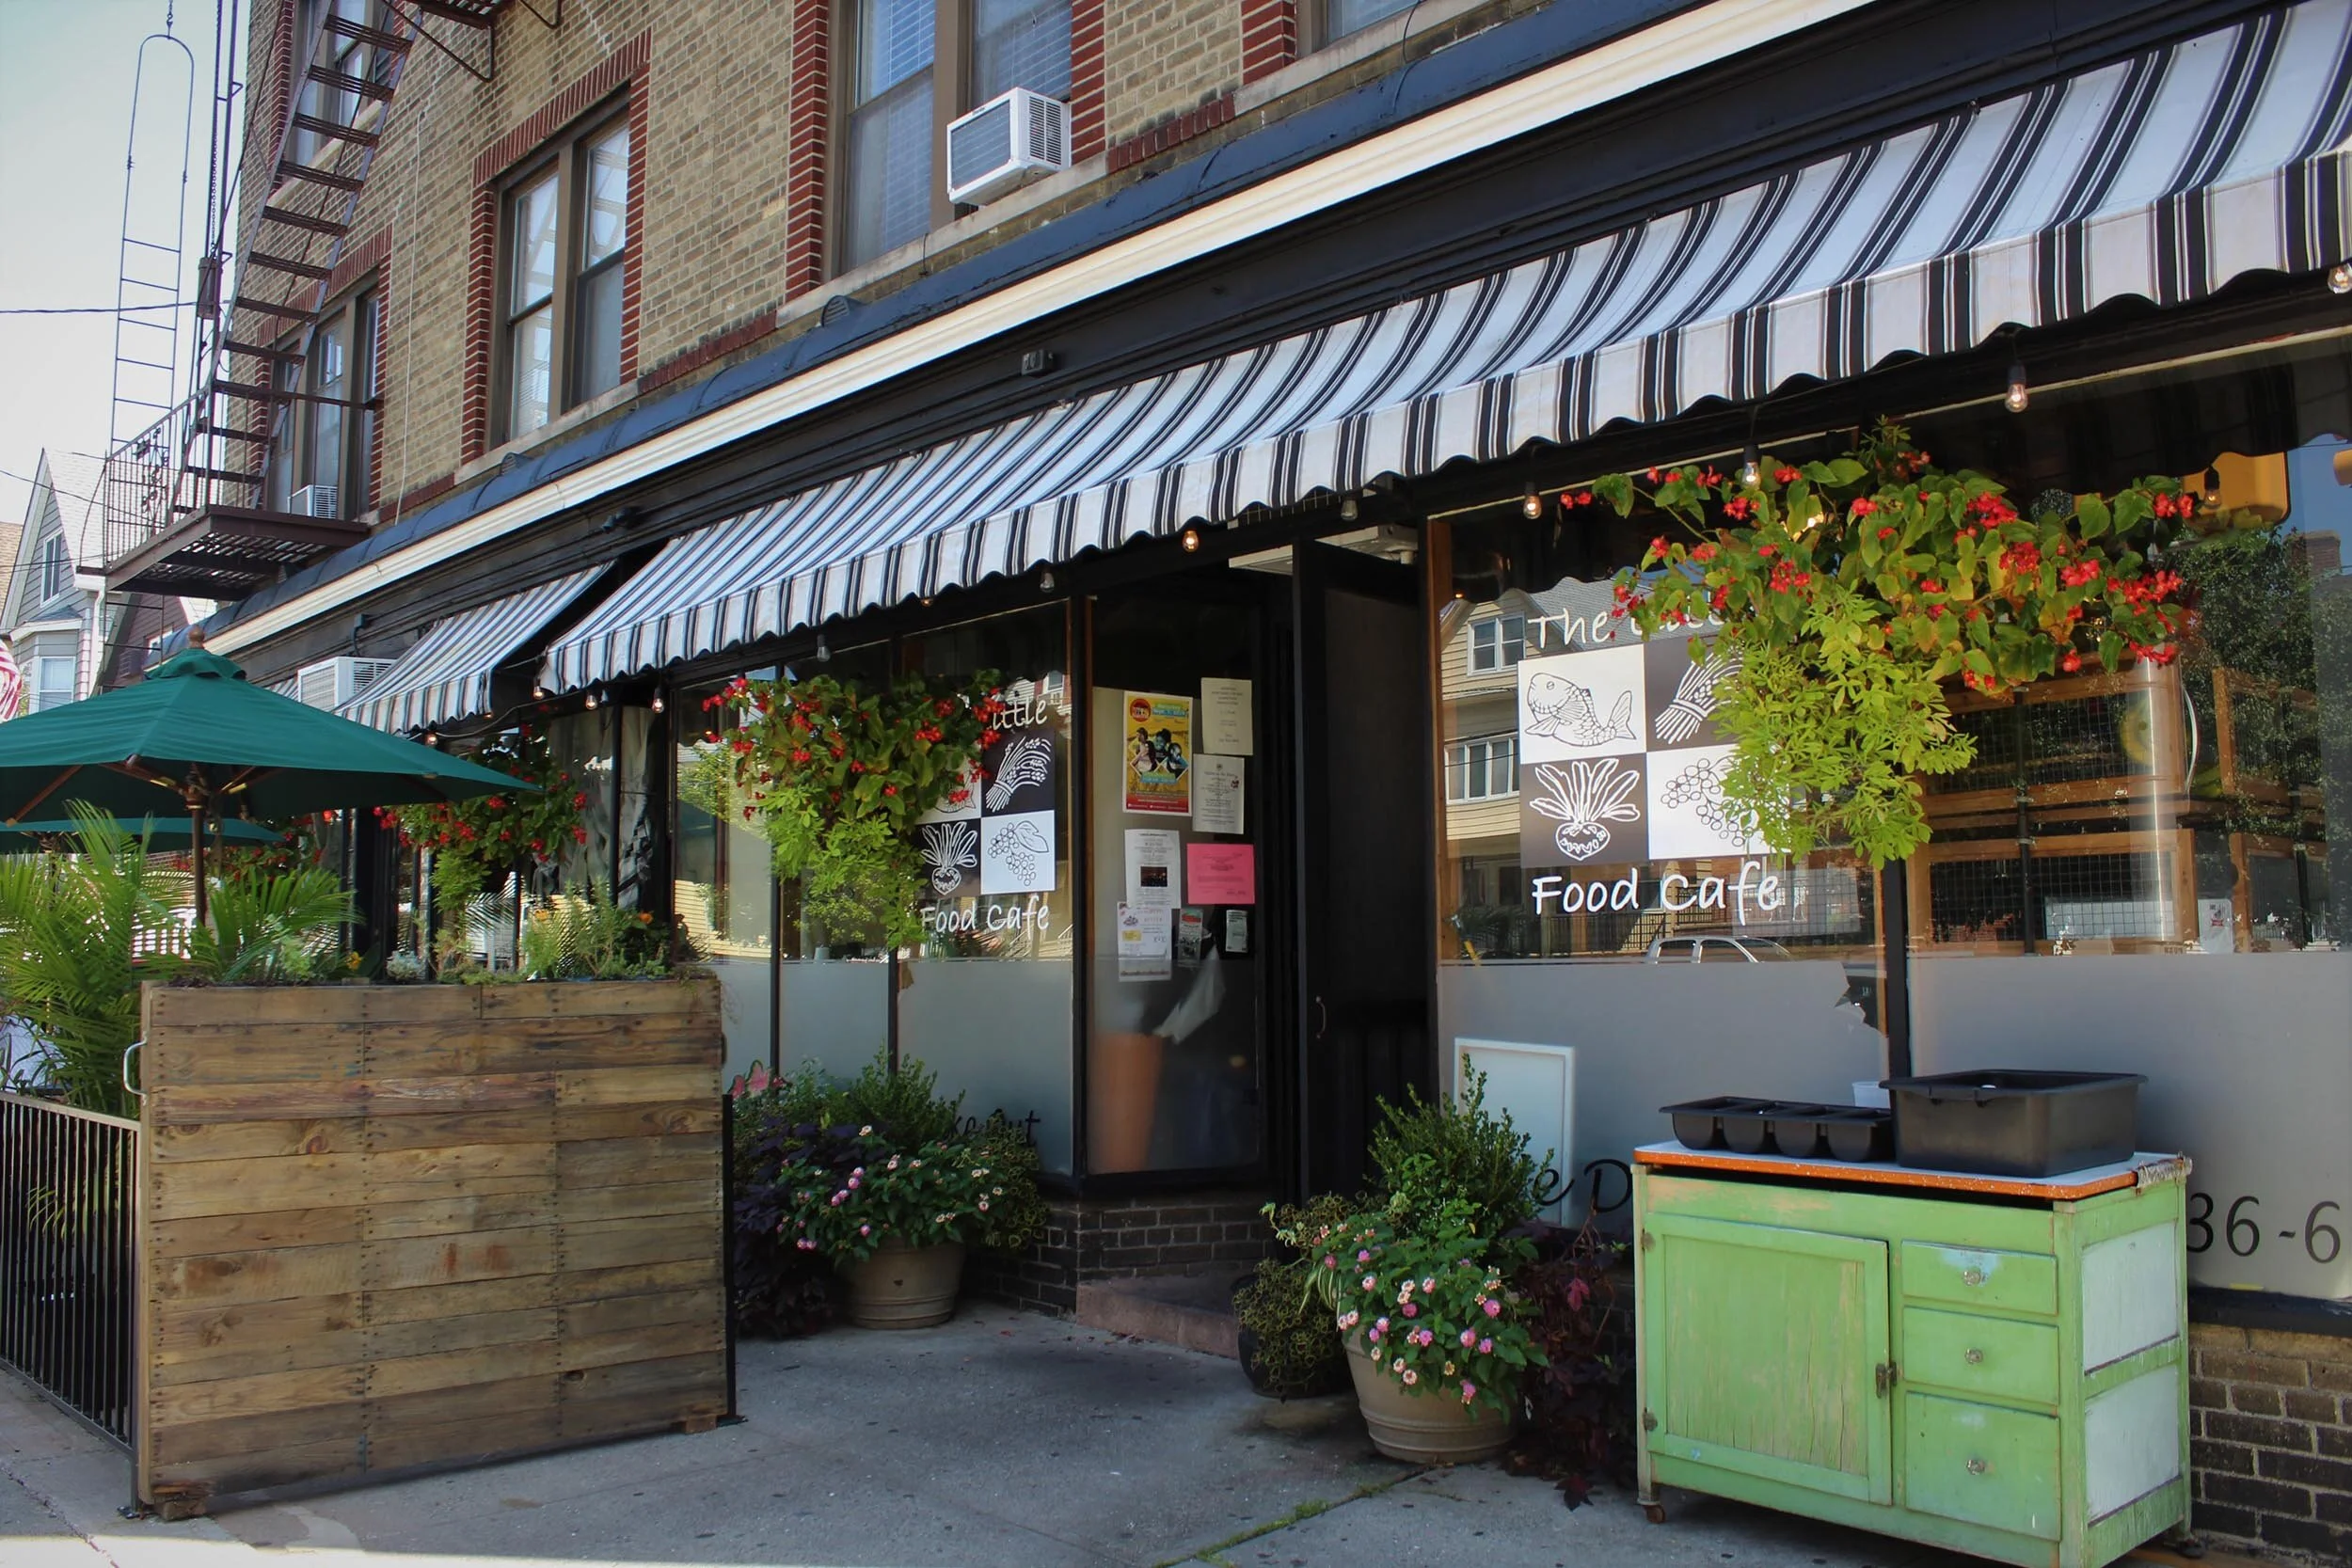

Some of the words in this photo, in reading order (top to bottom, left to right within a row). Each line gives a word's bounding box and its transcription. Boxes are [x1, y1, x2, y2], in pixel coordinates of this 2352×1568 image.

[1527, 607, 1612, 649] The
[992, 696, 1048, 731] ittle
[1531, 866, 1640, 915] Food
[920, 899, 977, 932] Food
